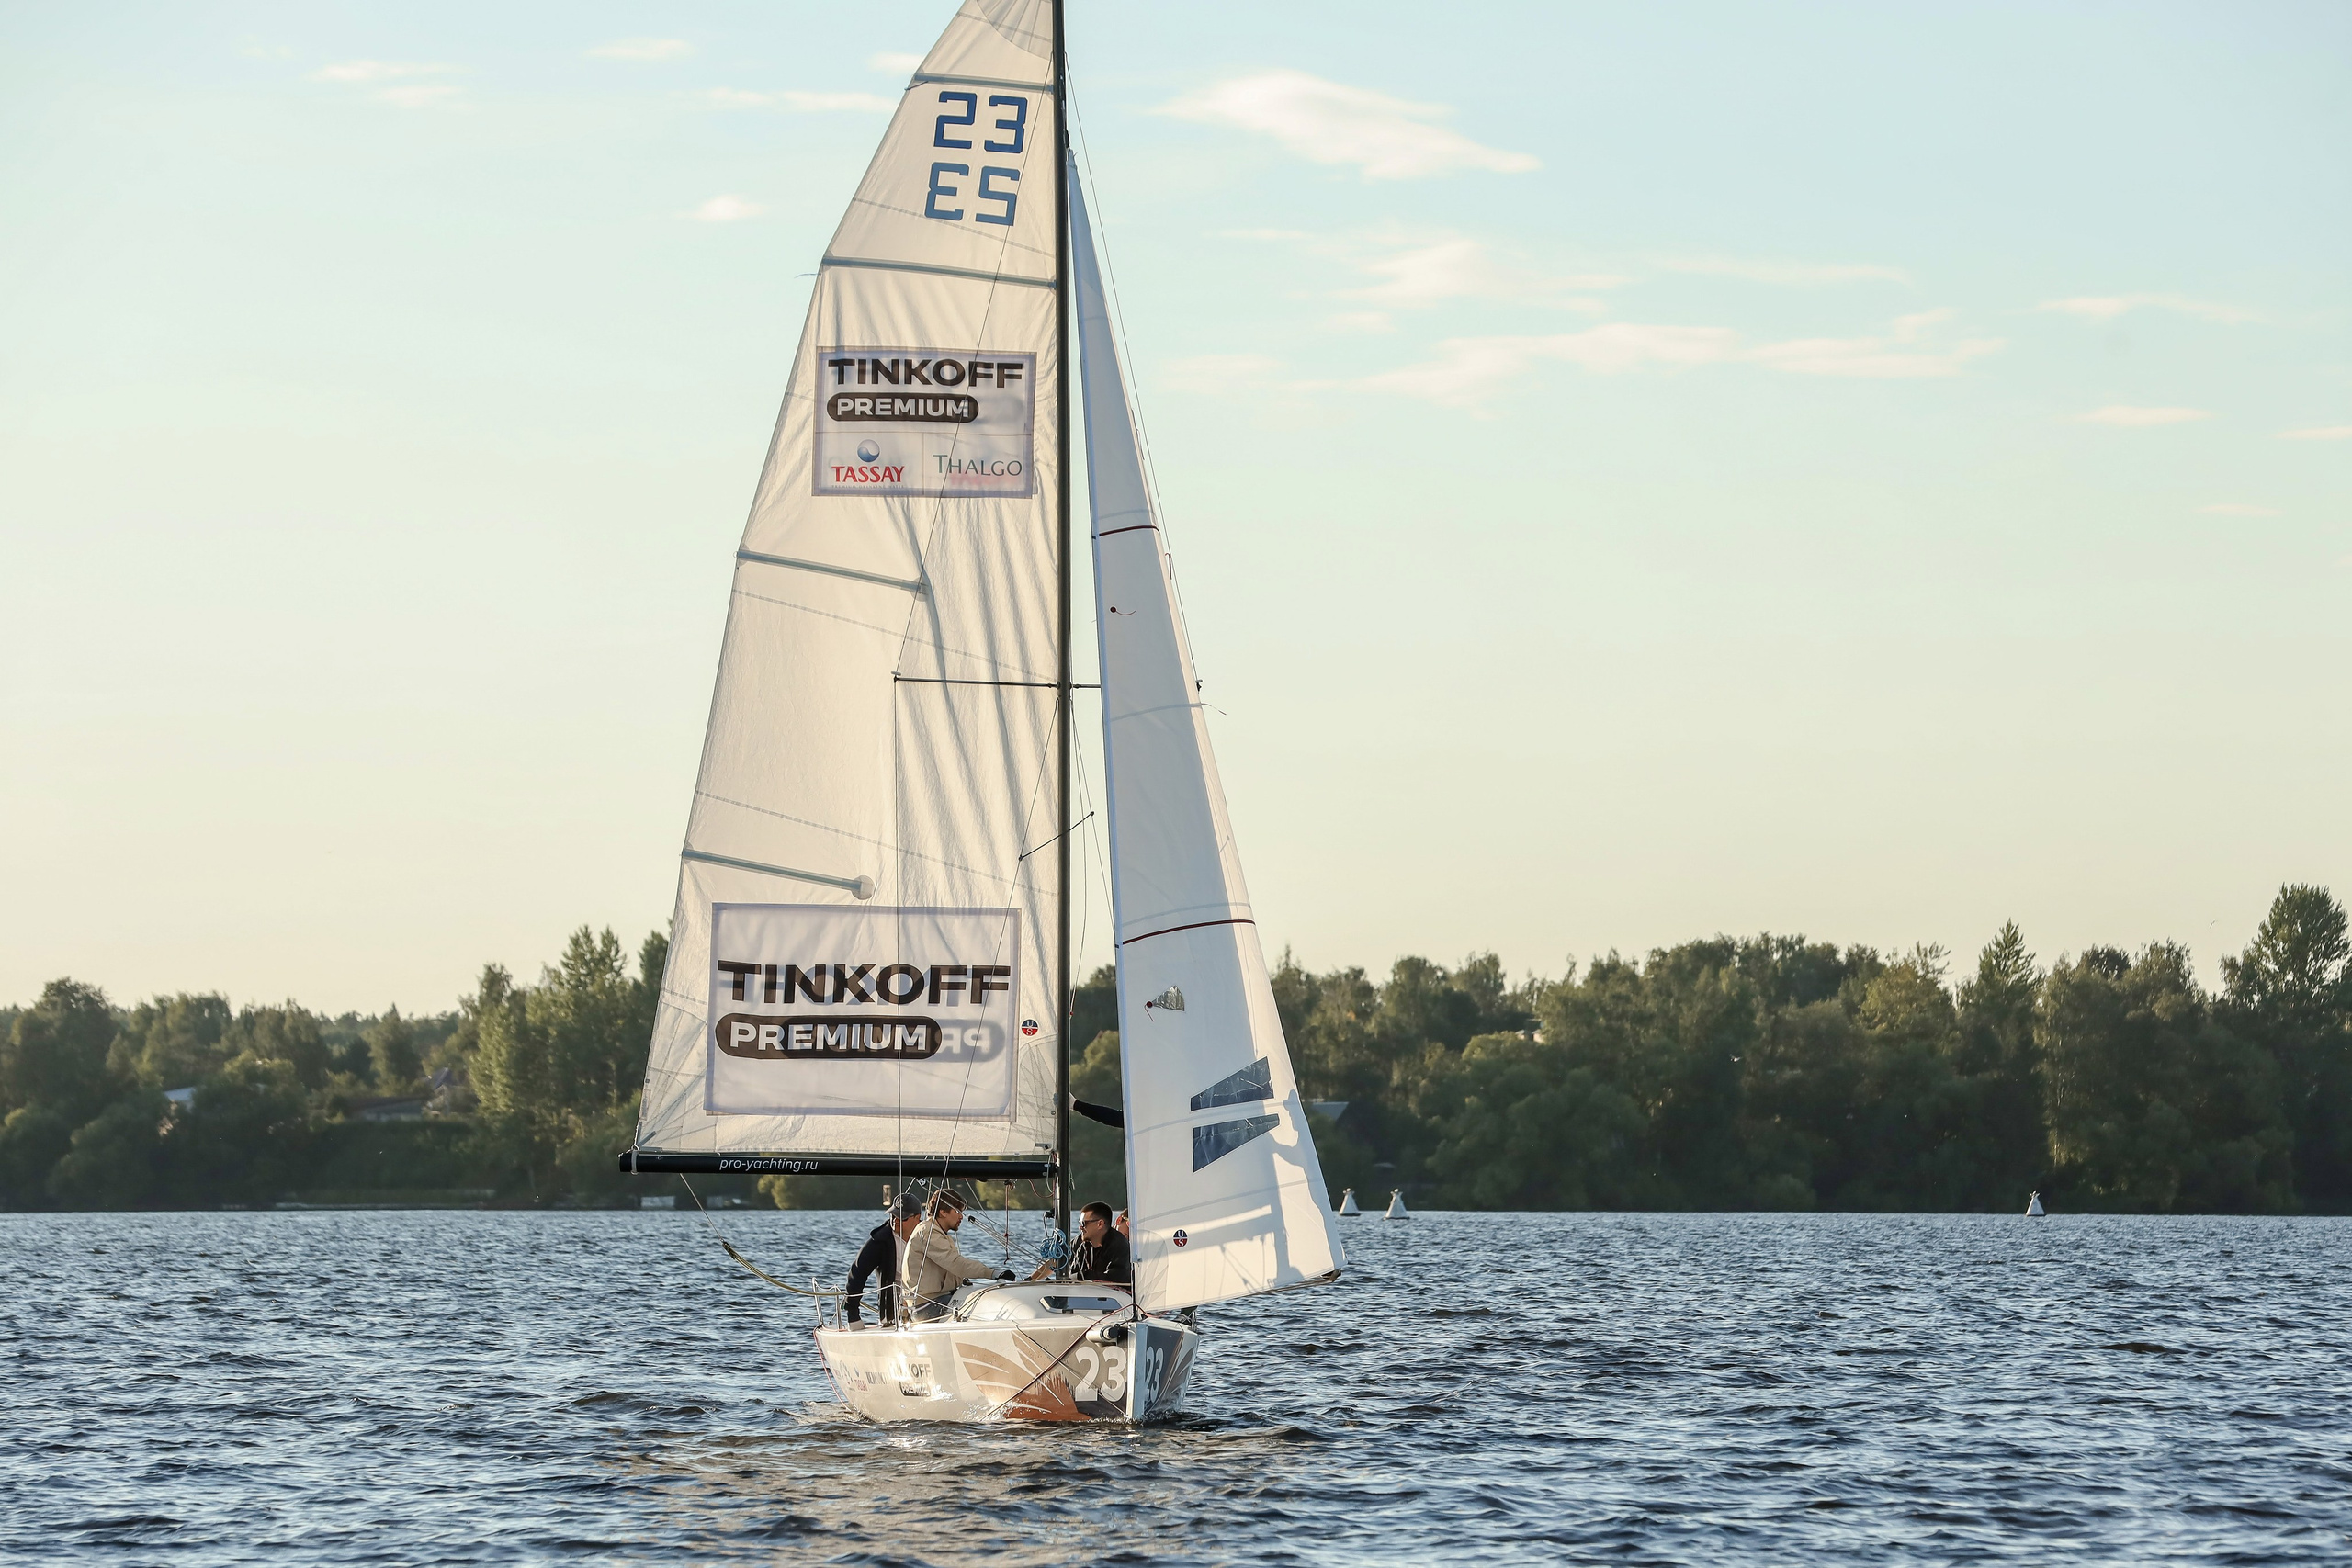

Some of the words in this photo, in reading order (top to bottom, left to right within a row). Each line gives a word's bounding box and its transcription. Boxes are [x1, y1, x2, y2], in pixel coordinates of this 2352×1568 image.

[933, 90, 1028, 154] 23
[828, 357, 1024, 389] TINKOFF
[836, 397, 970, 418] PREMIUM
[831, 465, 905, 483] TASSAY
[933, 454, 1023, 477] THALGO
[717, 959, 1012, 1005] TINKOFF
[729, 1021, 927, 1051] PREMIUM
[719, 1157, 819, 1173] pro-yachting.ru
[1075, 1346, 1127, 1402] 23
